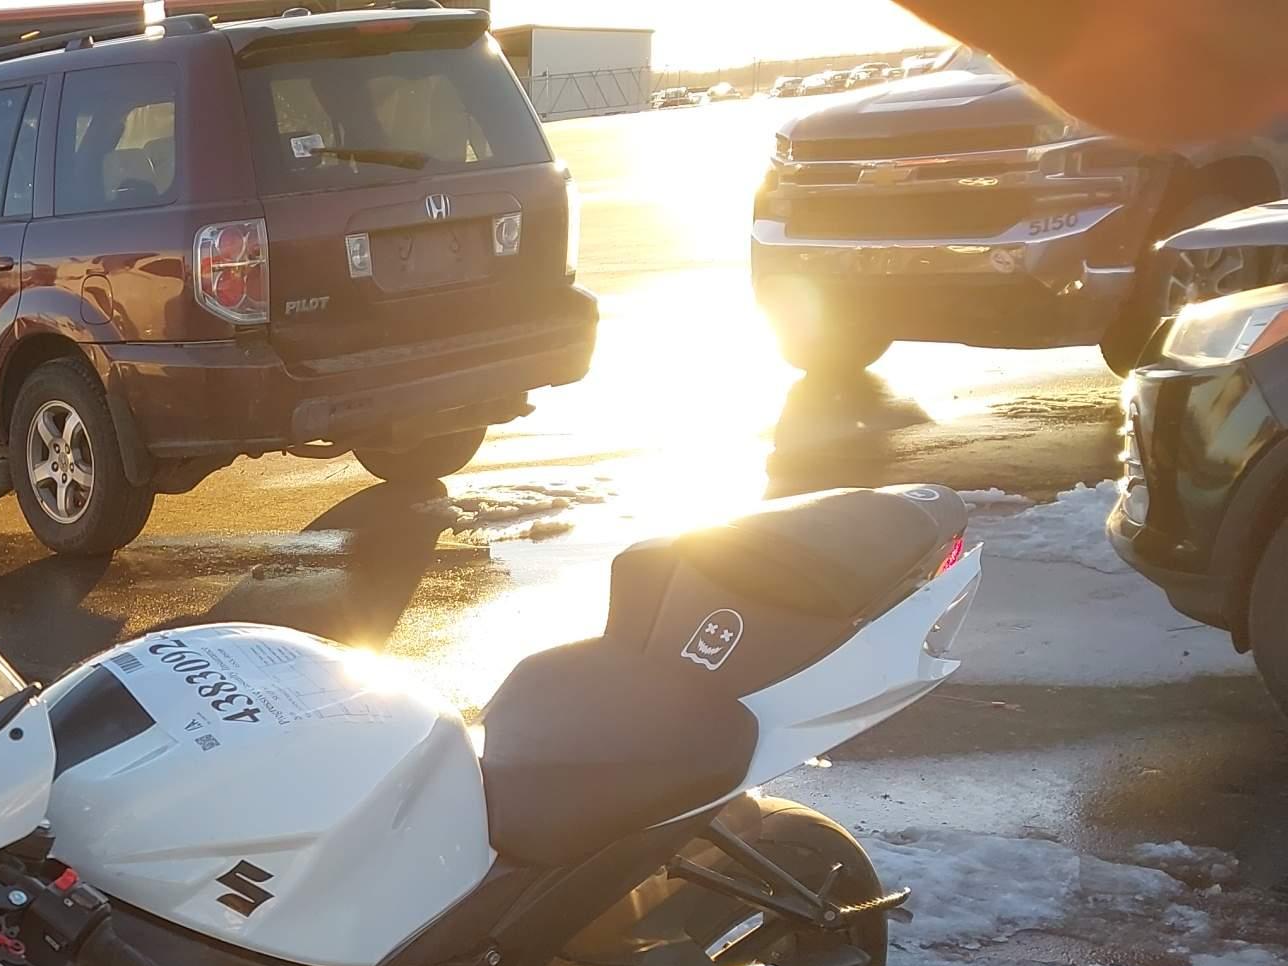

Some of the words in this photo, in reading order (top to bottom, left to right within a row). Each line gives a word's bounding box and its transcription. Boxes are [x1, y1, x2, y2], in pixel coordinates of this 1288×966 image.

[1029, 214, 1078, 235] 5150
[285, 296, 330, 315] PILOT
[148, 633, 261, 723] 4383092
